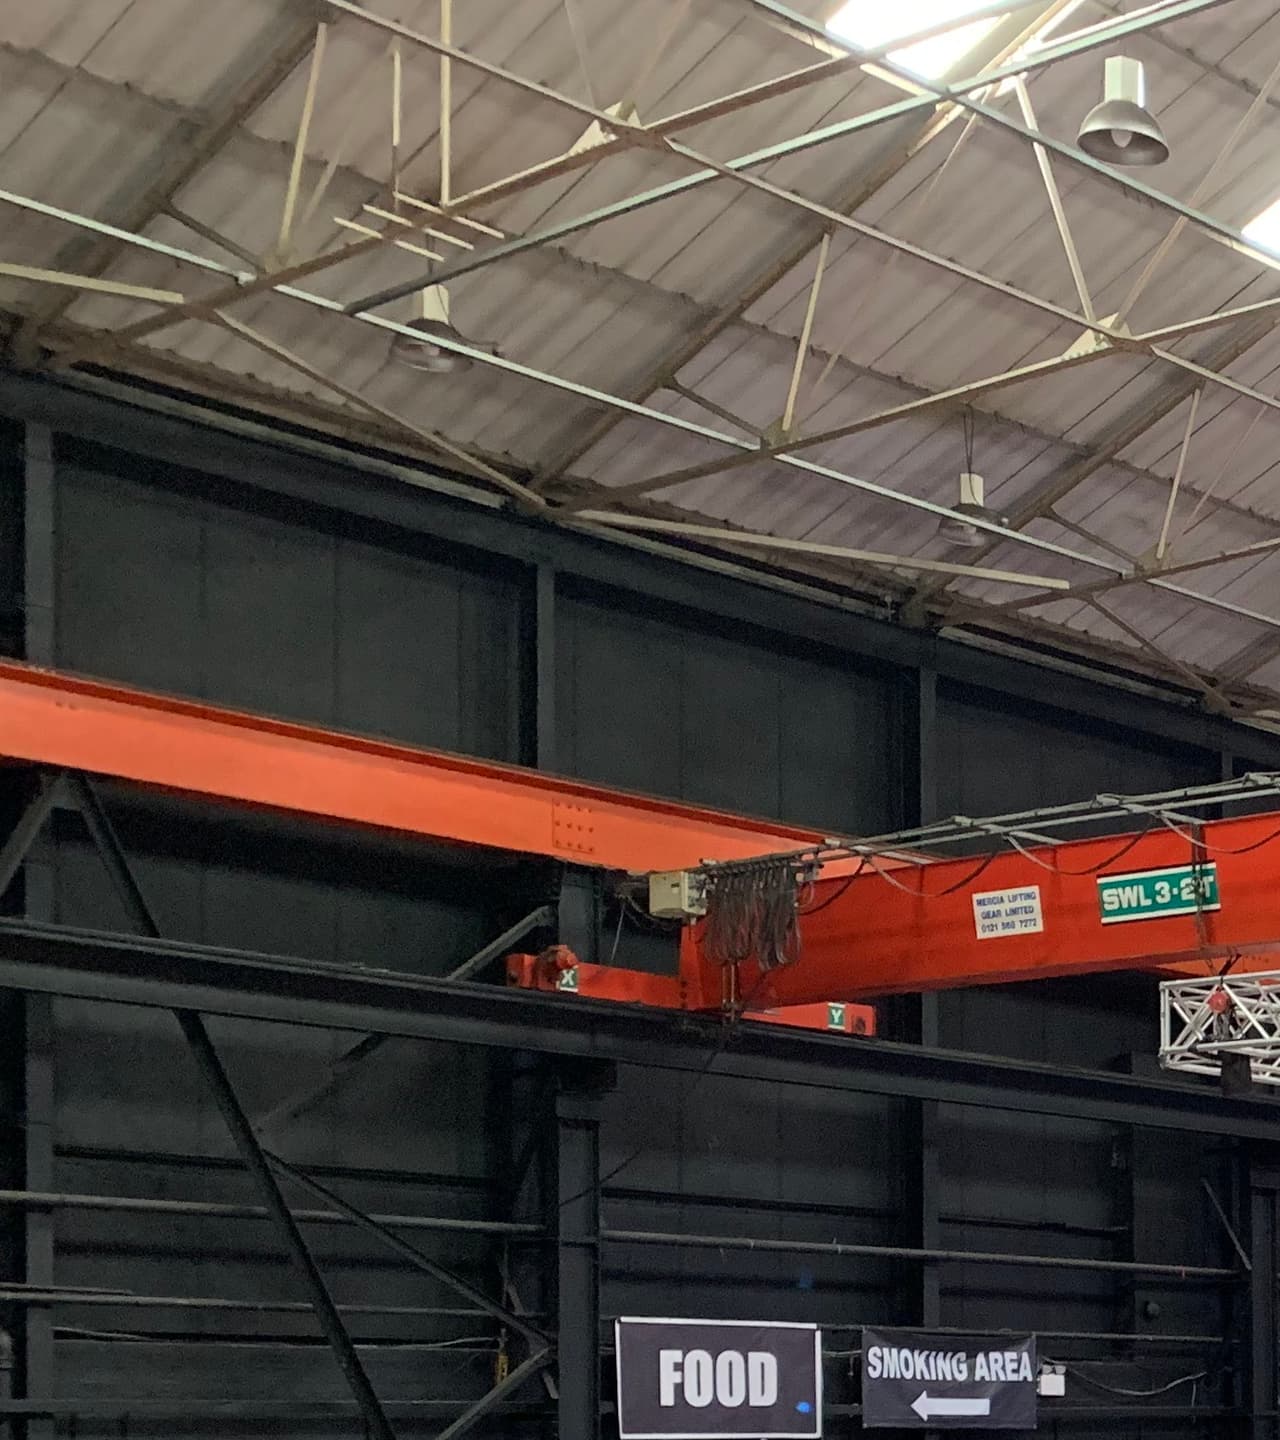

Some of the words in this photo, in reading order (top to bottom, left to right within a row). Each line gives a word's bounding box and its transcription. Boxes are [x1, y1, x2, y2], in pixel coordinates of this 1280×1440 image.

[1102, 885, 1153, 911] SWL
[831, 1009, 843, 1024] Y
[658, 1348, 778, 1408] FOOD
[867, 1346, 968, 1382] SMOKING
[974, 1351, 1033, 1382] AREA
